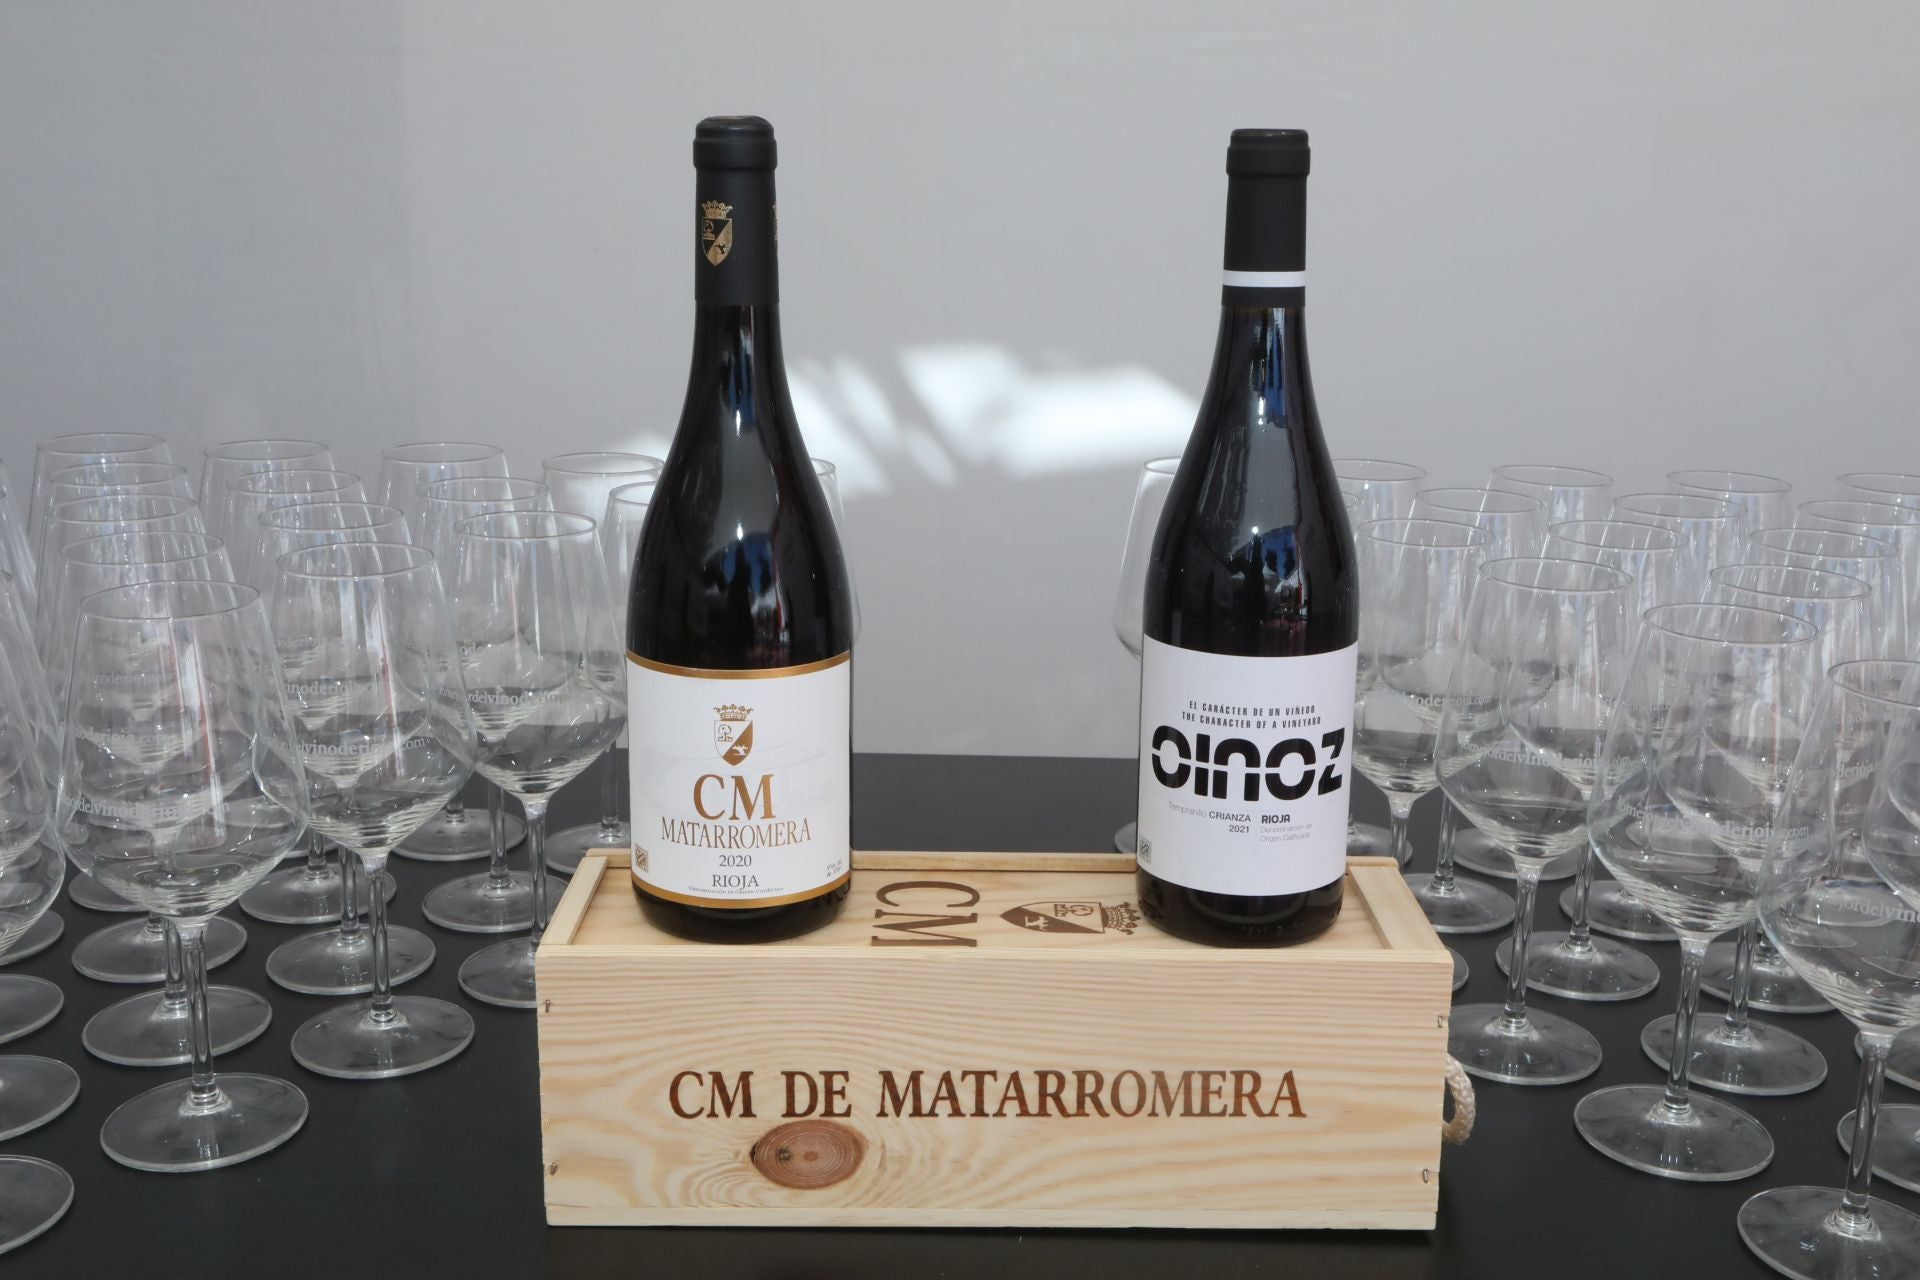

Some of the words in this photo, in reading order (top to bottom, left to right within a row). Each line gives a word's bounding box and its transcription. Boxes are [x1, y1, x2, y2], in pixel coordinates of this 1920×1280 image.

[1189, 700, 1197, 710] EL
[1202, 703, 1248, 716] CARÁCTER
[1253, 707, 1263, 716] DE
[1268, 707, 1280, 716] UN
[1285, 704, 1315, 716] VIÑEDO
[1182, 711, 1195, 721] THE
[1200, 715, 1251, 728] CHARACTER
[1256, 720, 1266, 729] OF
[1272, 720, 1277, 728] A
[1282, 716, 1321, 729] VINEYARD
[693, 773, 776, 821] CM
[1168, 800, 1207, 817] Tempranillo
[1208, 811, 1251, 822] CRIANZA
[1261, 814, 1290, 824] RIOJA
[661, 815, 811, 850] MATARROMERA
[1229, 824, 1250, 833] 2021
[1259, 835, 1281, 844] Origen
[719, 854, 752, 867] 2020
[712, 874, 760, 890] RIOJA
[870, 880, 980, 948] CM
[669, 1070, 756, 1118] CM
[781, 1070, 850, 1118] DE
[876, 1069, 1307, 1118] MATARROMERA
